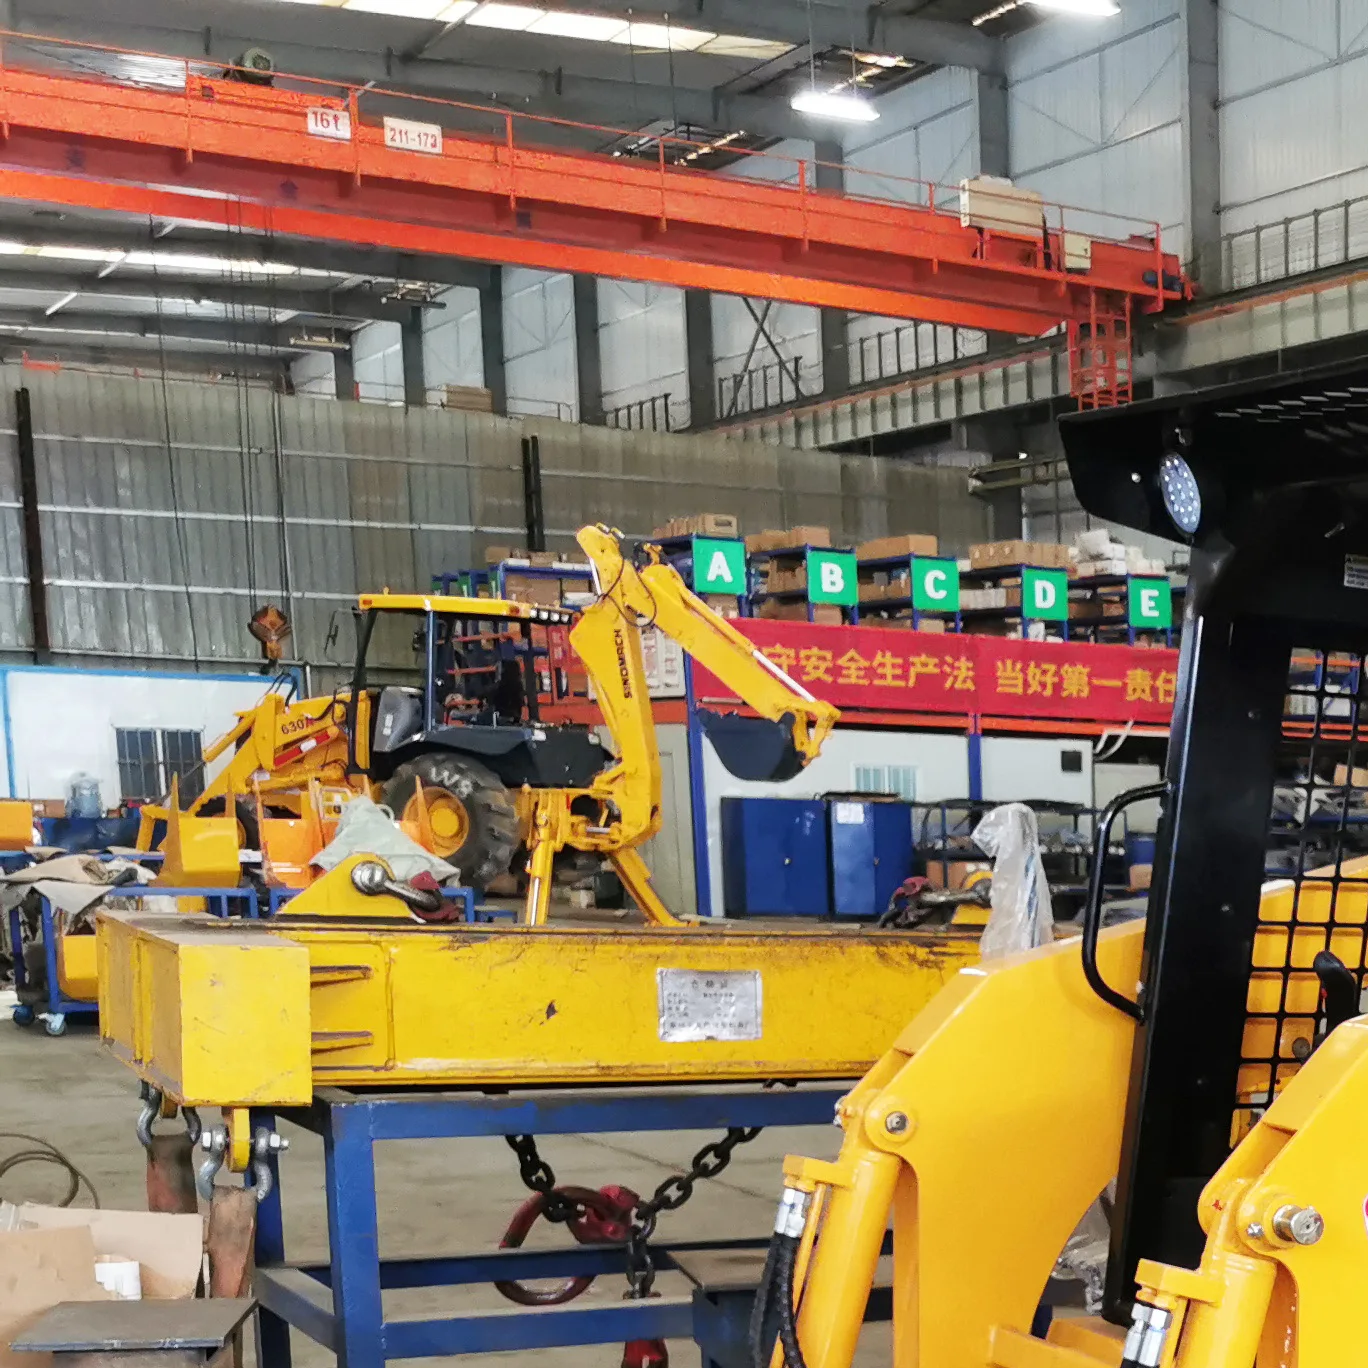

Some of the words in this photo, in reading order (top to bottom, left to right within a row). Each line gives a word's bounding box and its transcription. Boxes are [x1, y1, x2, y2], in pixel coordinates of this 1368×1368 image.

[707, 551, 733, 583] A
[820, 562, 845, 594] B
[924, 569, 947, 600] C
[1035, 579, 1057, 610] D
[1140, 588, 1160, 618] E
